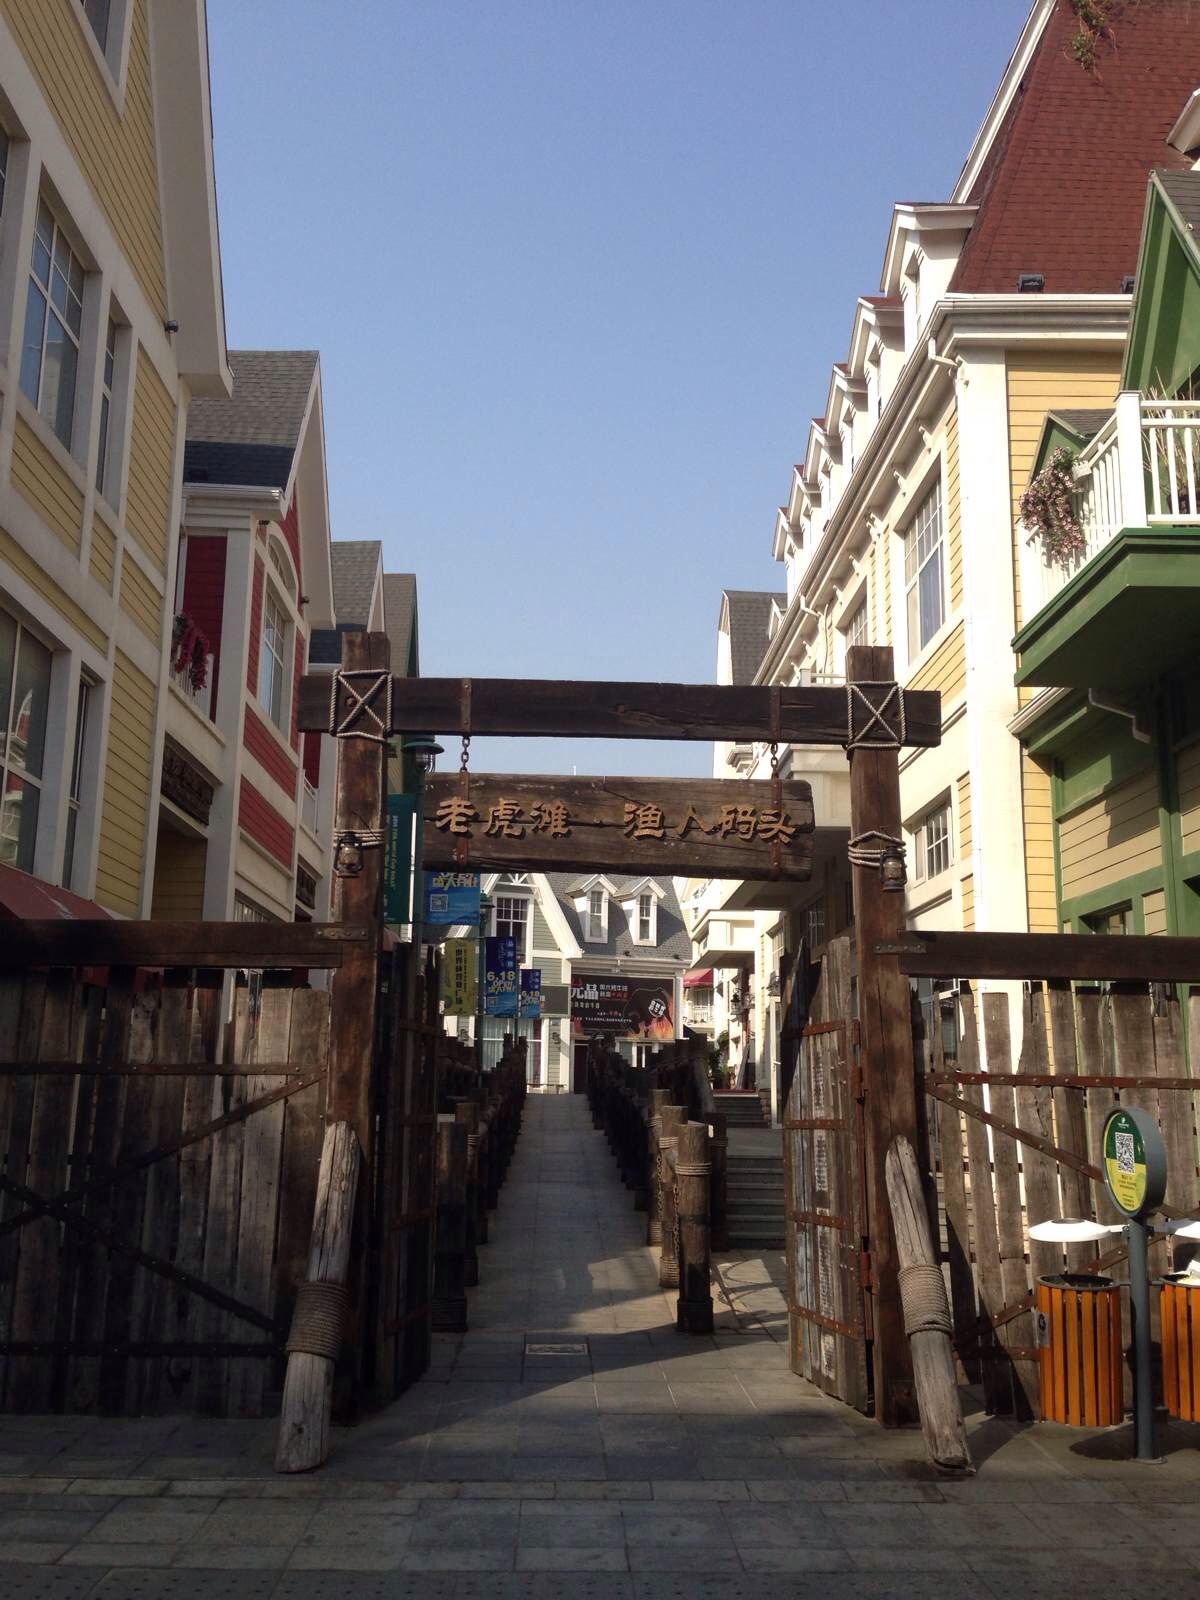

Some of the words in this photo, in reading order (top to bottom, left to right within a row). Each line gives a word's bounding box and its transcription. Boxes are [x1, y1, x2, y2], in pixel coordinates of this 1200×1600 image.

[435, 796, 572, 837] 老虎滩
[624, 802, 797, 842] 渔人码头
[487, 971, 516, 981] 6.18
